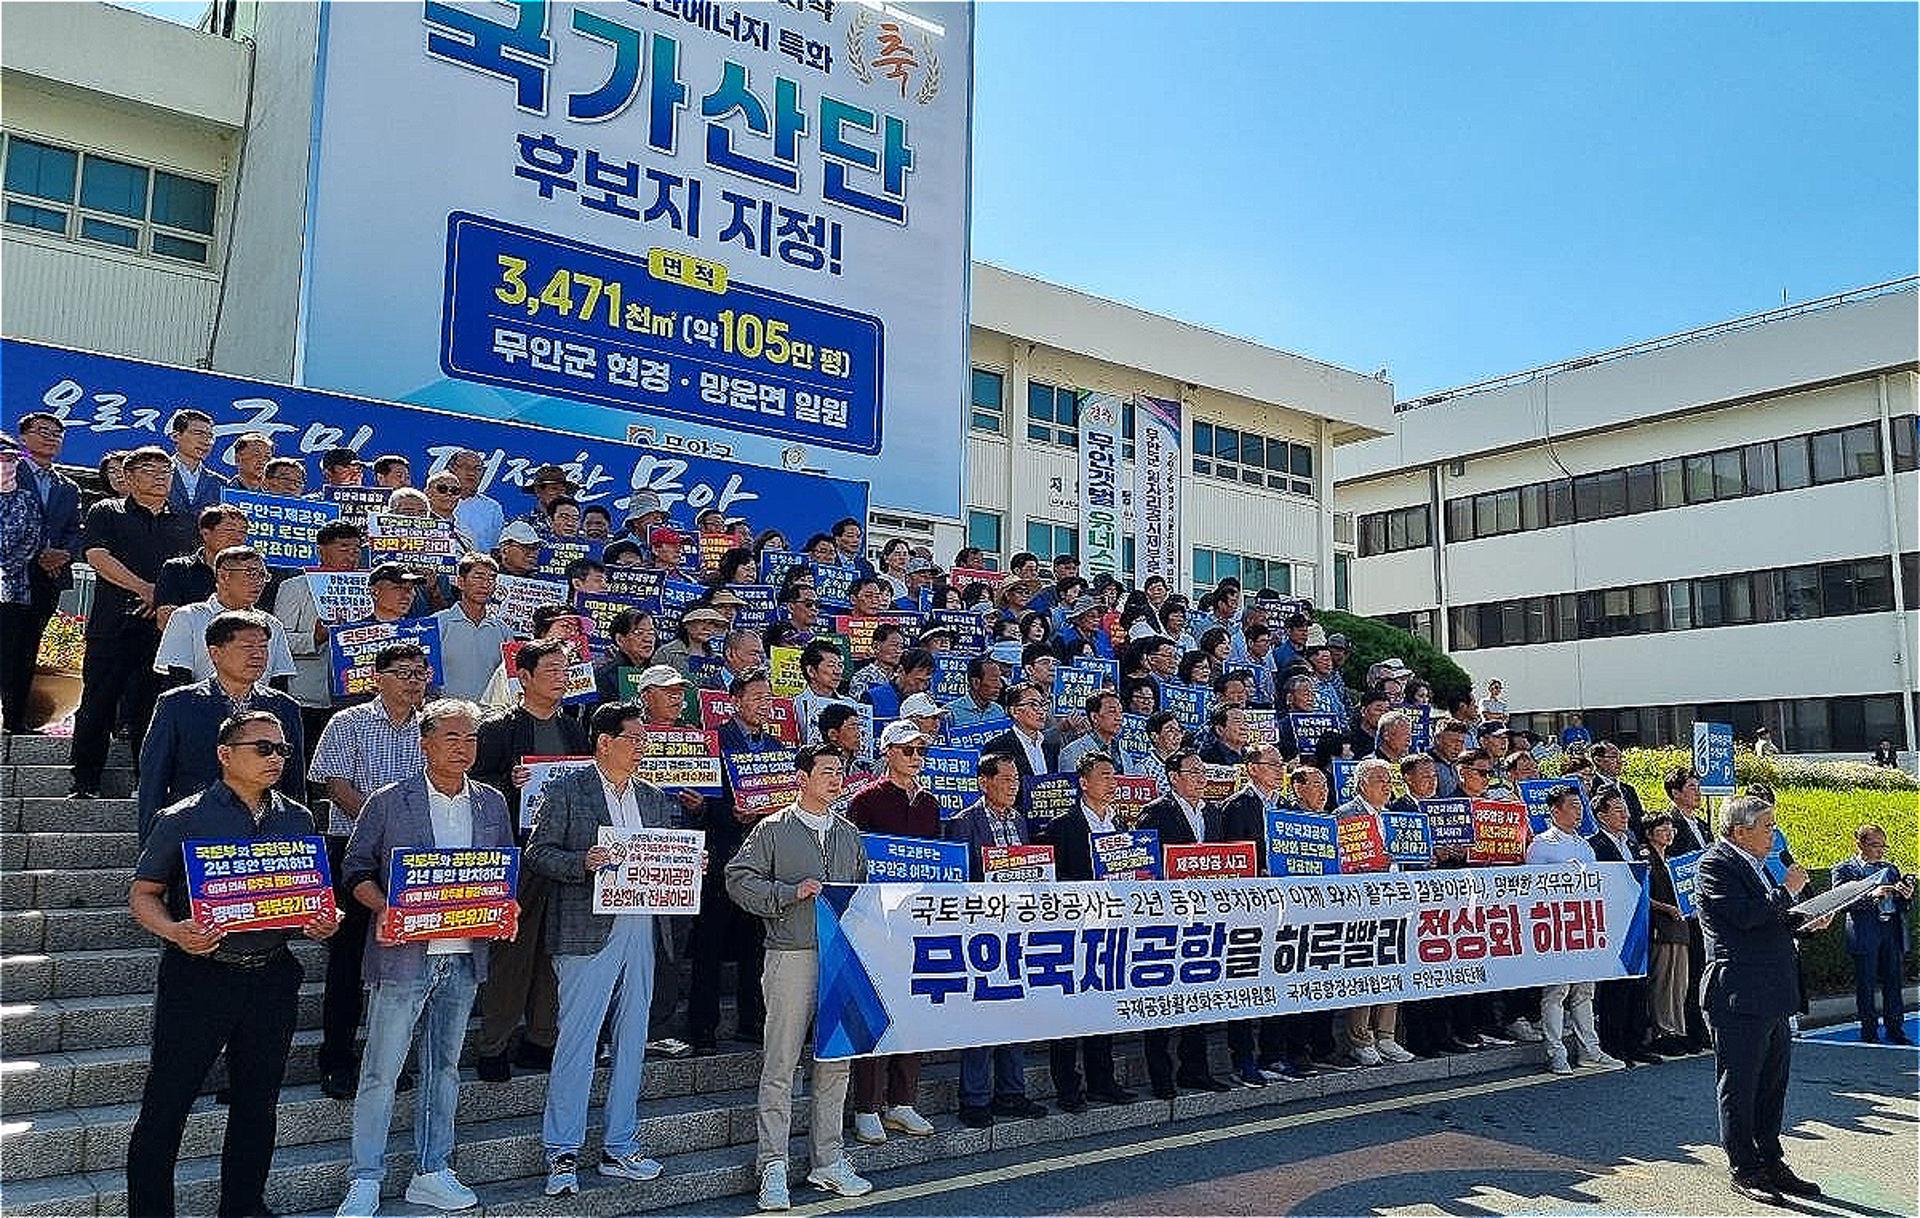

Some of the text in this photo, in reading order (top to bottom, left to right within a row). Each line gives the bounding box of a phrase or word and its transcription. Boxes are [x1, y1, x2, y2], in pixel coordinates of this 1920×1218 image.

[628, 0, 769, 51] 에너지
[778, 28, 833, 74] 특화
[424, 0, 916, 226] 국가산단
[512, 132, 844, 276] 후보지 지정!
[662, 256, 716, 287] 면 적
[492, 328, 849, 428] 무안군 현경 망운면 일원
[240, 501, 328, 525] 무안국제공항
[1087, 511, 1116, 577] 유네스
[920, 757, 970, 774] 국제공항
[204, 856, 315, 877] 2년 동안 방치하다
[405, 867, 507, 885] 2년 동안 방치하다
[627, 865, 695, 887] 무안국제공항
[911, 870, 1604, 926] 국토부와 공항공사는 2년 동안 방치하다 이제 와서 활주로 결함이라니, 명백한 직무유기다
[911, 899, 1607, 1004] 무안국제공항을 하루빨리 정상화 하라!
[1116, 966, 1488, 1020] 국제공항활성화추진위원회 국제공항정상화협의체 무안군사회단체
